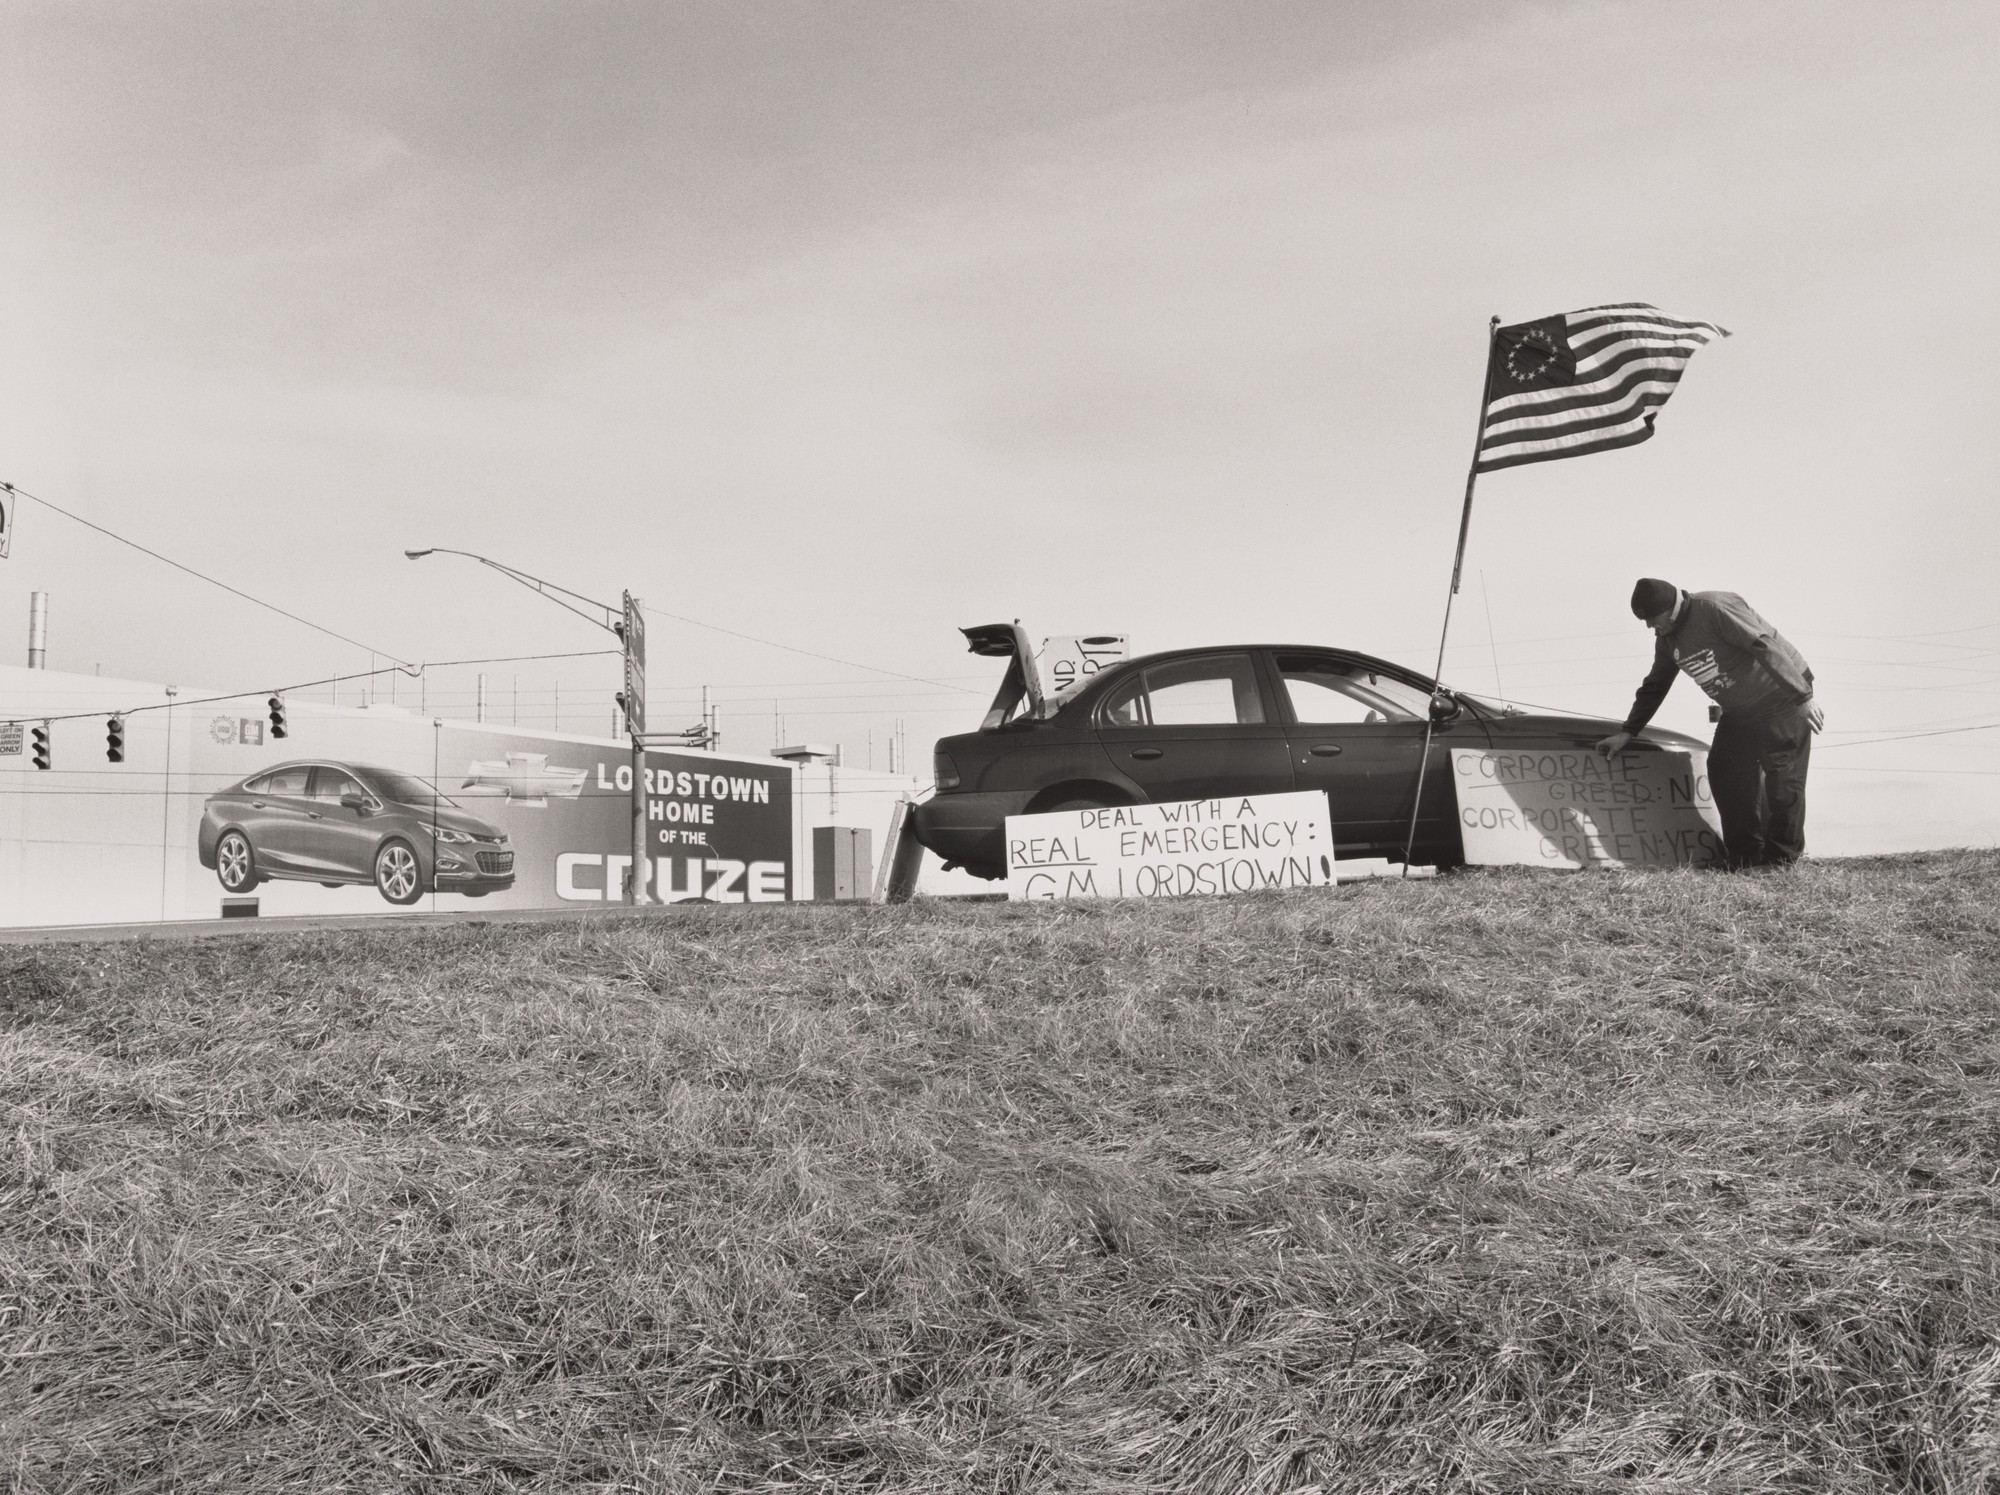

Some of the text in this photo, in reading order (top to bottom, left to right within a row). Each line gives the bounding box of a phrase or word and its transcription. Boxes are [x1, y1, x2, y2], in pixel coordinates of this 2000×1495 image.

[244, 723, 259, 736] GM
[1669, 774, 1712, 803] NO
[649, 800, 714, 824] HOME
[1080, 798, 1256, 829] DEAL WITH A
[1462, 806, 1648, 834] CORPORATE
[659, 829, 707, 845] OF THE
[1010, 820, 1317, 865] REAL EMERGENCY:
[555, 852, 785, 905] CRUZE
[1025, 868, 1099, 900] GM
